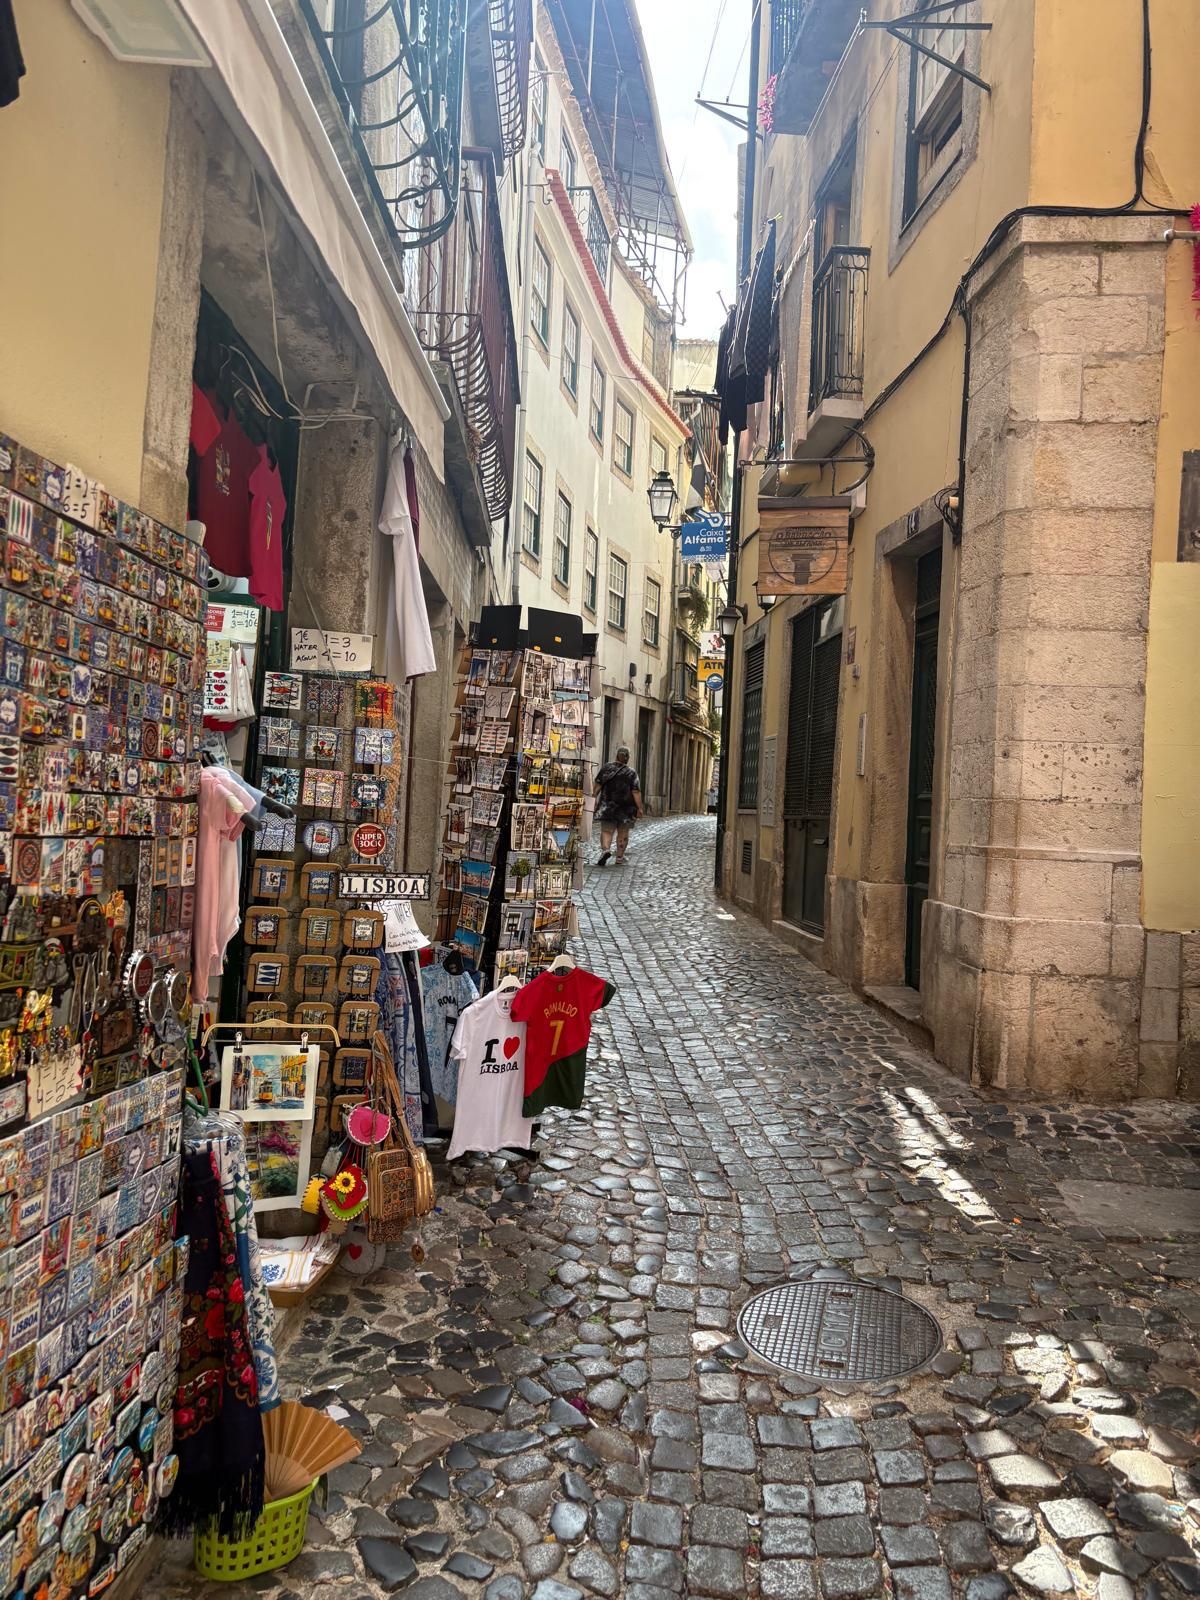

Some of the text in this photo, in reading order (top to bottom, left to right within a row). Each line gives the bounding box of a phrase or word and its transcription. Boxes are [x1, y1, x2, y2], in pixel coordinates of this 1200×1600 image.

[699, 528, 724, 537] Caixa
[684, 535, 724, 545] Alfama
[356, 833, 382, 841] SUPER
[357, 840, 382, 848] BOCK
[347, 878, 421, 893] LISBOA
[549, 1020, 564, 1056] 7
[481, 1038, 499, 1065] I
[479, 1061, 519, 1075] LISBOA
